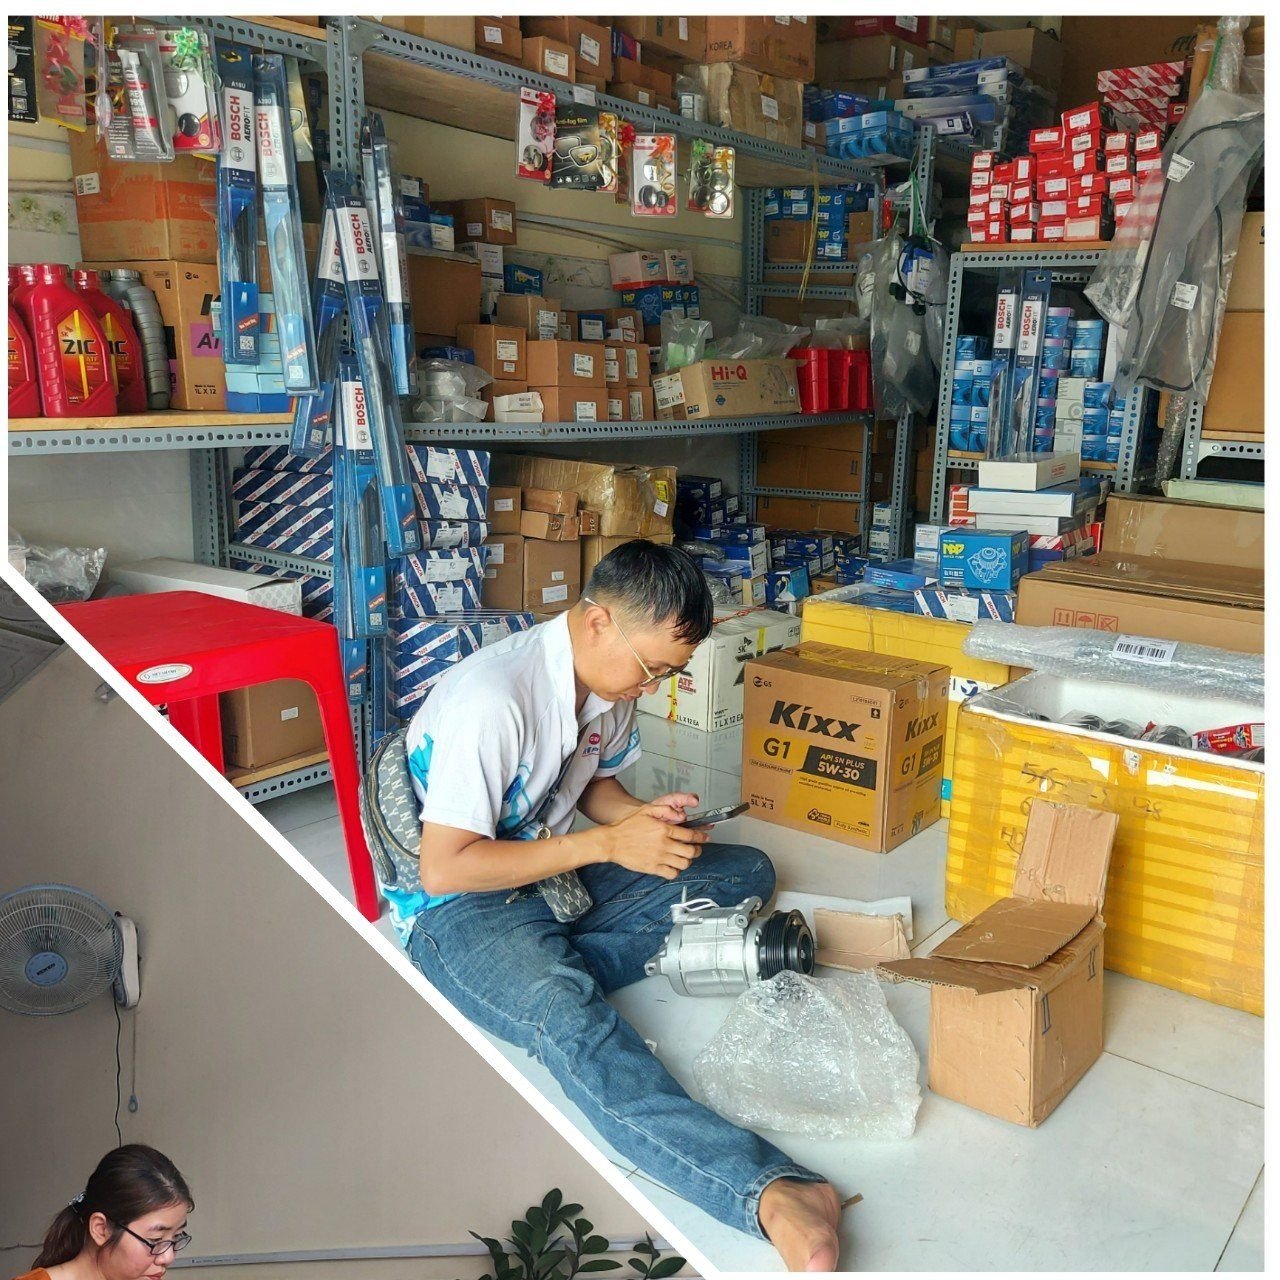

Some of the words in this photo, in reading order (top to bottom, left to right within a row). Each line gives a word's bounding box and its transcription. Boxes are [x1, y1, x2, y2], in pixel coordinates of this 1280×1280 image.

[230, 95, 241, 141] BOSCH
[243, 106, 252, 142] AEROFIT
[258, 113, 272, 156] BOSCH
[351, 213, 365, 254] BOSCH
[998, 299, 1007, 330] BOSCH
[1023, 305, 1033, 336] BOSCH
[62, 339, 98, 355] ZIC
[108, 340, 128, 355] IC
[711, 365, 749, 381] Hi-Q
[354, 387, 366, 426] BOSCH
[987, 601, 999, 619] BOSCH
[678, 676, 694, 687] ATF
[763, 680, 772, 688] GS
[769, 700, 862, 742] Kixx
[905, 712, 939, 742] Kixx
[763, 737, 791, 759] G1
[817, 761, 860, 781] 5W-30
[820, 753, 834, 762] API
[834, 756, 845, 764] SN
[845, 759, 865, 769] PLUS
[901, 752, 917, 776] G1
[750, 798, 760, 807] 5L
